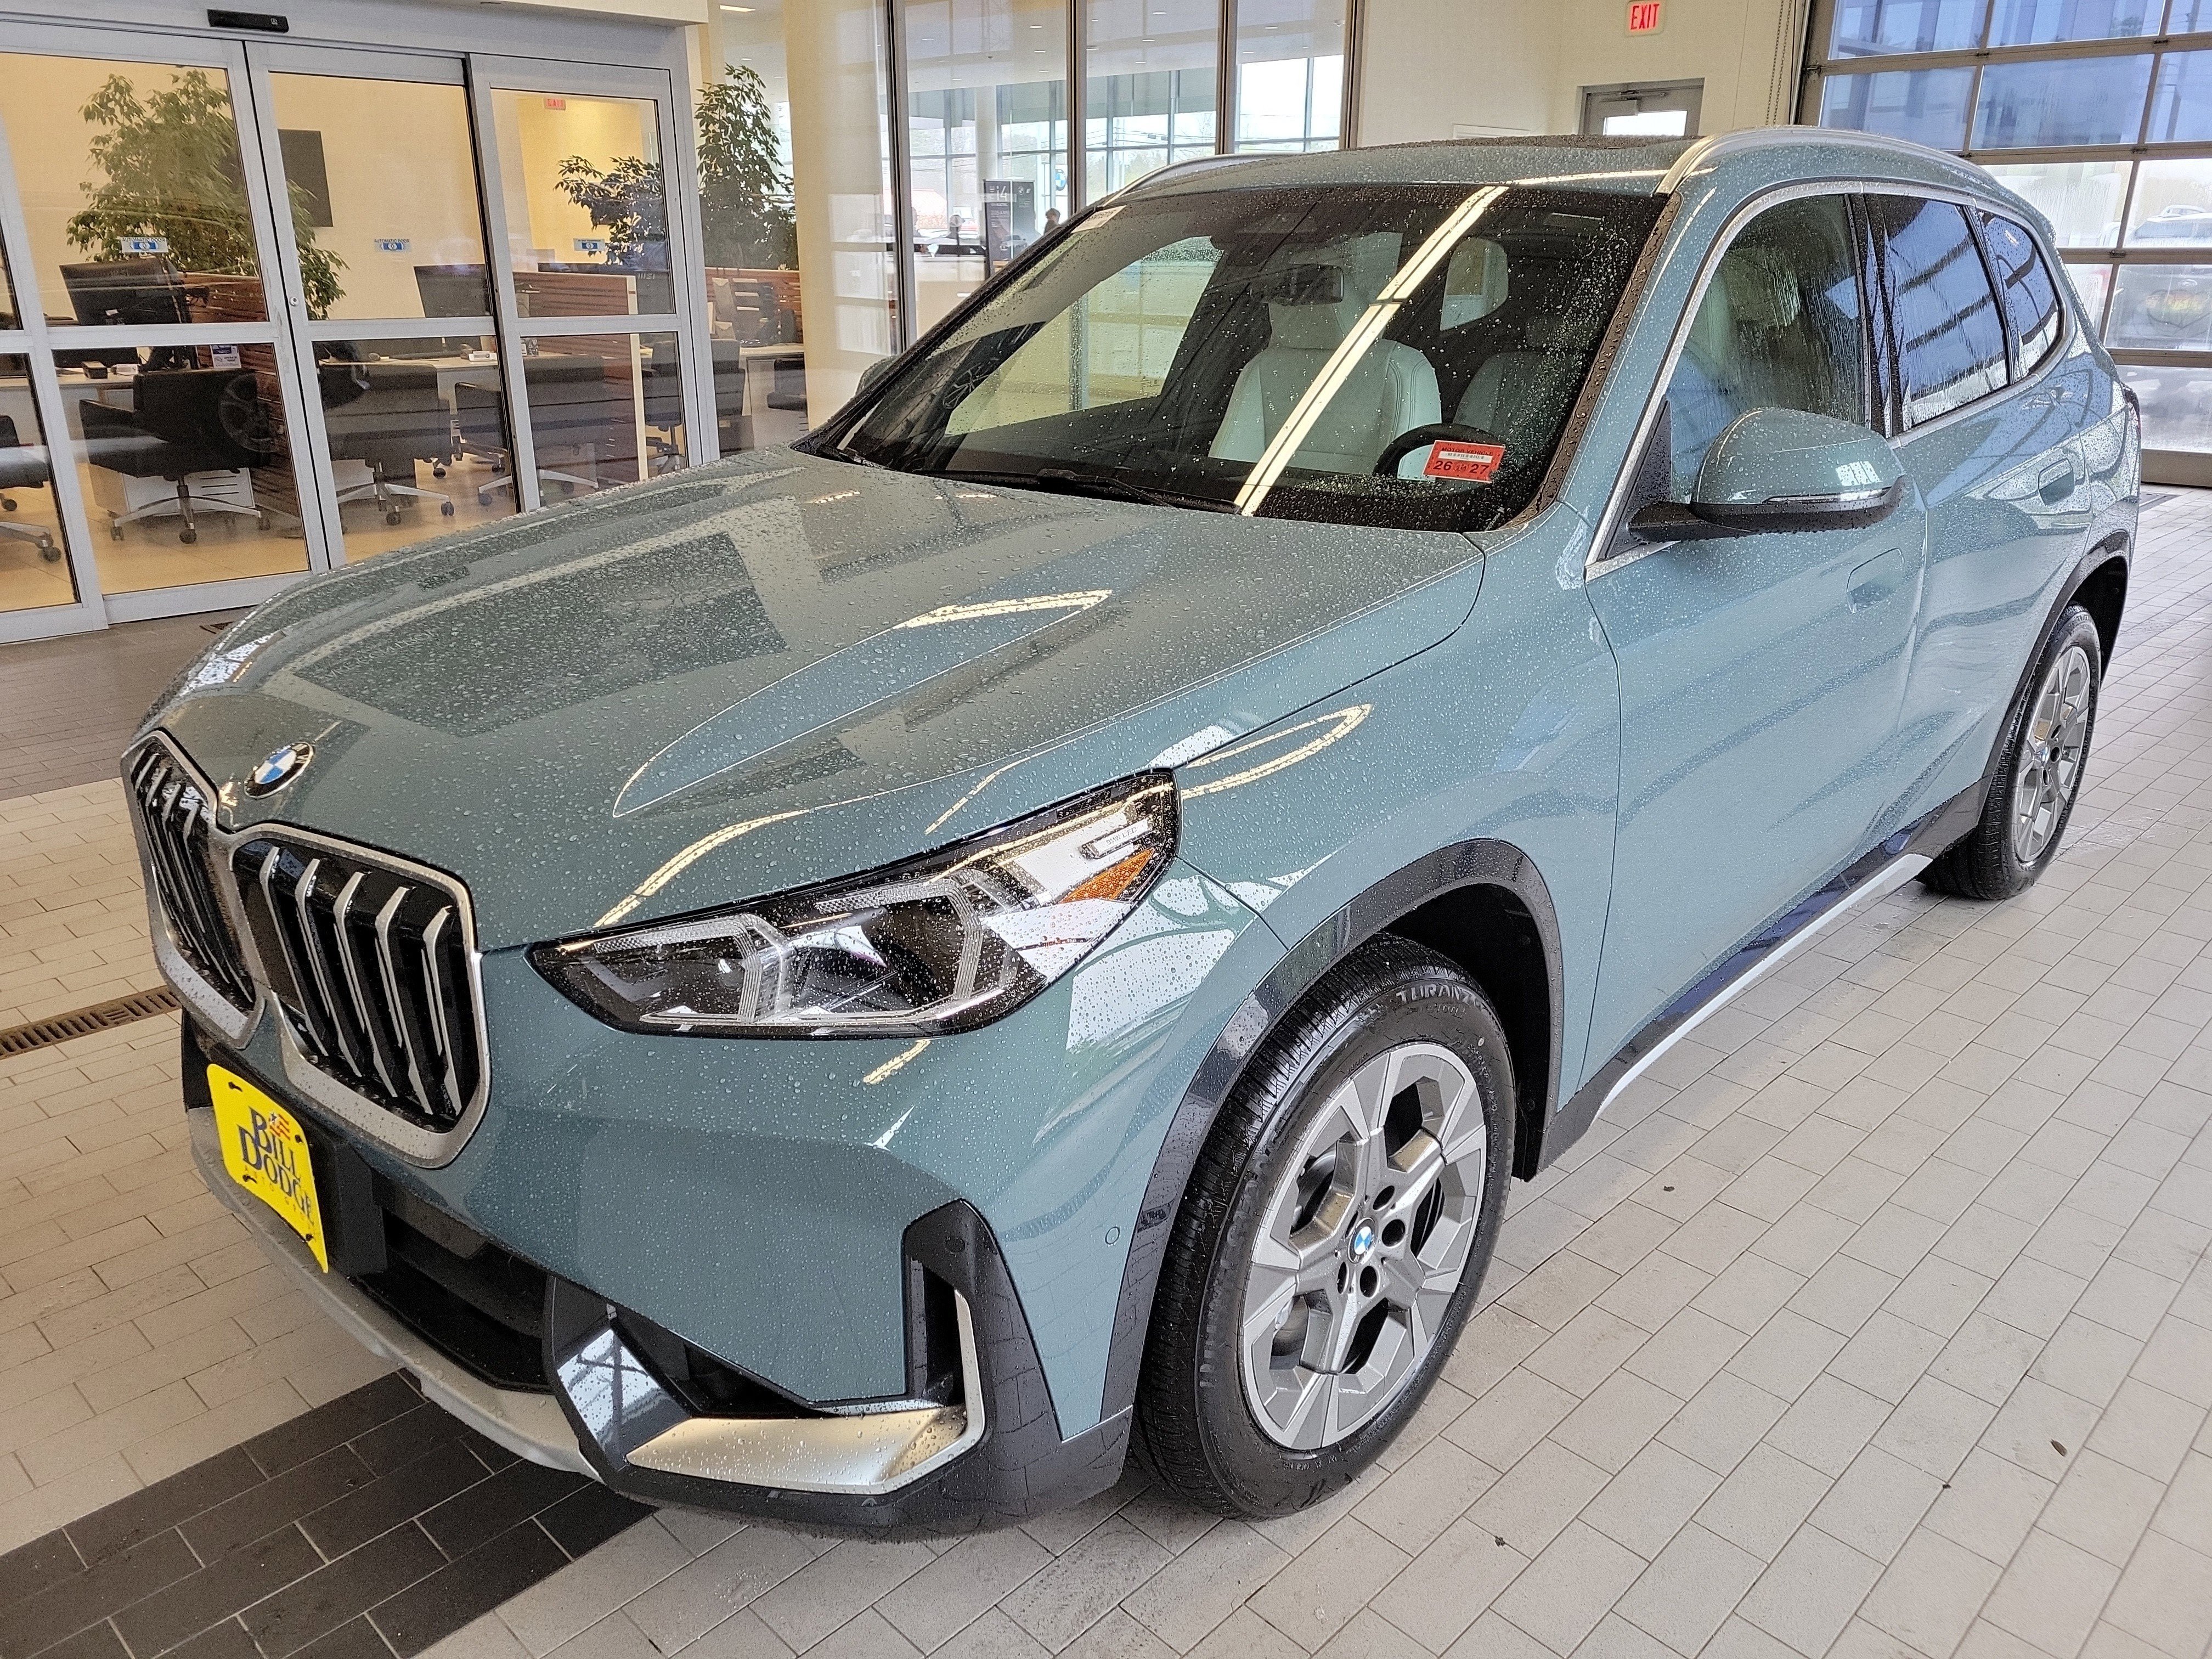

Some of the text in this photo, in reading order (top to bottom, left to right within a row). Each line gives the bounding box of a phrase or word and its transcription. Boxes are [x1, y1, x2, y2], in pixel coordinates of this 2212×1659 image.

[1630, 3, 1659, 30] EXIT
[1433, 460, 1453, 471] 26
[1469, 464, 1489, 475] 27
[1122, 827, 1137, 838] LED
